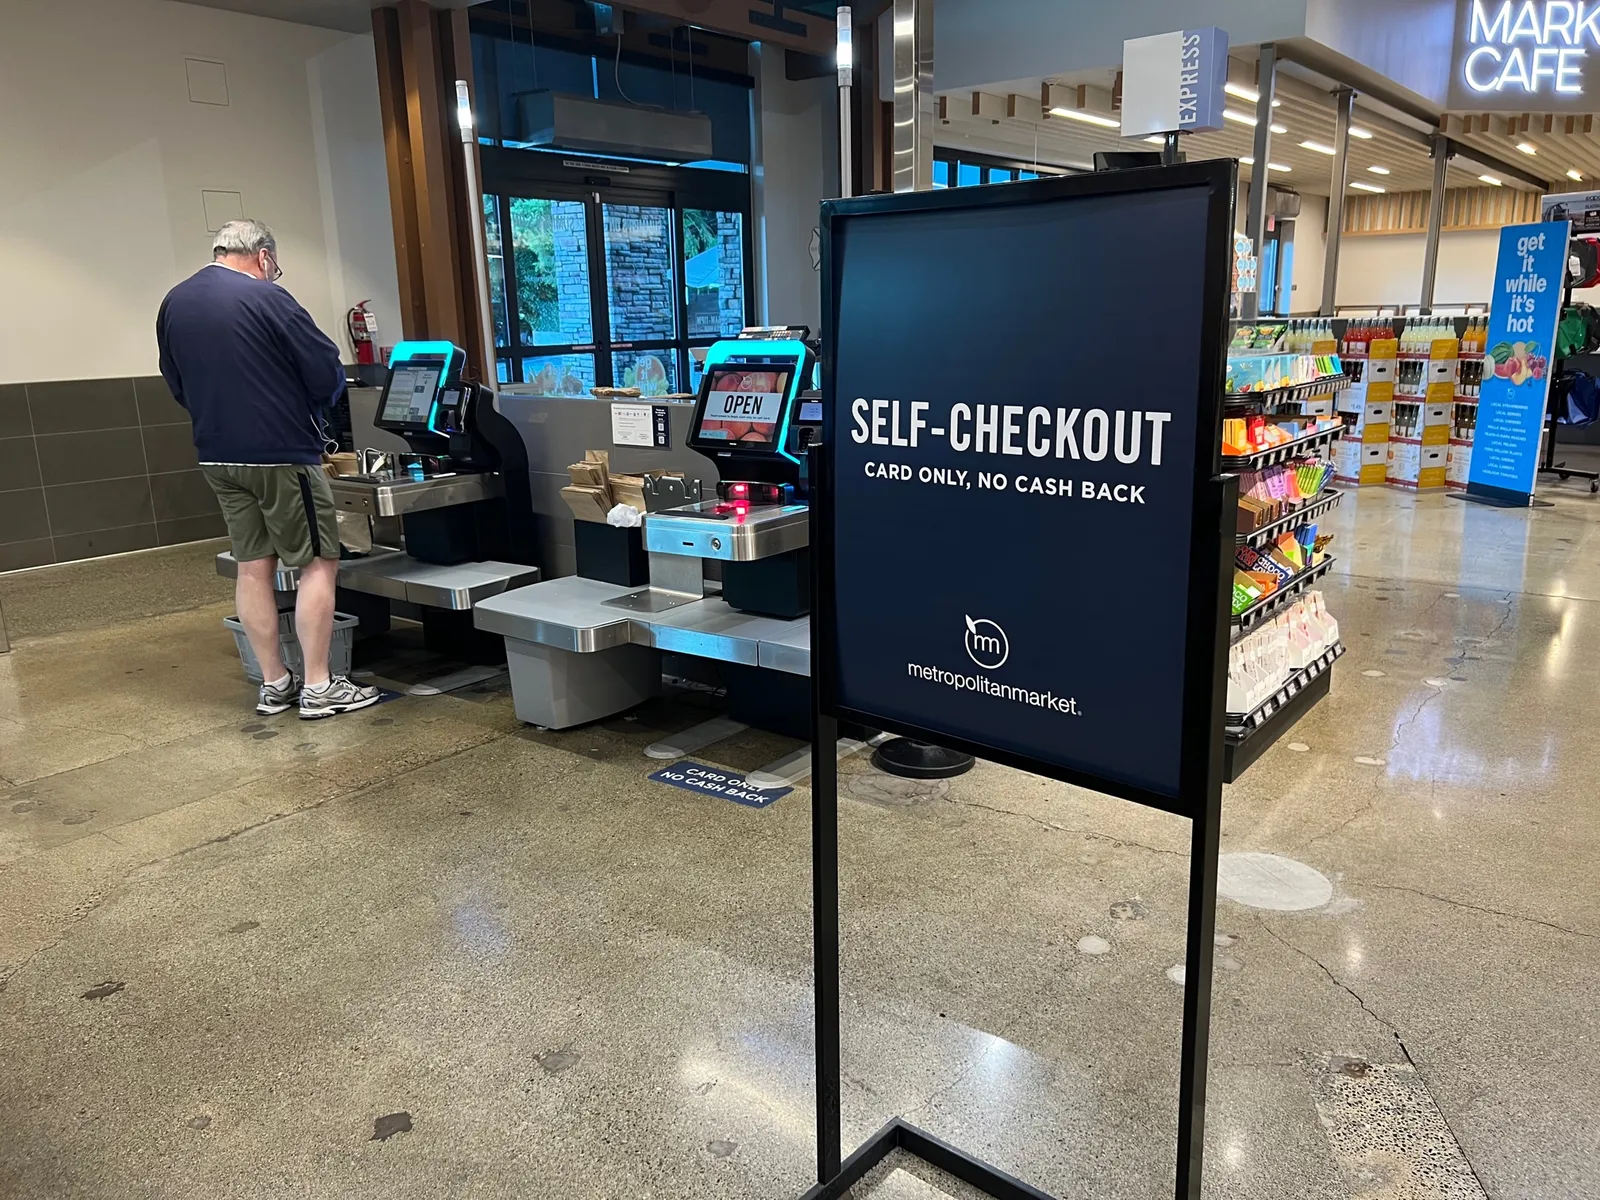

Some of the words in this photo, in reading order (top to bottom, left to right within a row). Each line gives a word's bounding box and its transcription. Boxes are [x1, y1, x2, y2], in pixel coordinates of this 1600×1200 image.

[1469, 0, 1600, 45] MARK
[1179, 34, 1200, 124] EXPRESS
[1464, 46, 1586, 92] CAFE
[1517, 232, 1545, 256] get
[1522, 253, 1535, 272] it
[1505, 273, 1547, 293] while
[1510, 294, 1535, 313] it's
[1506, 314, 1535, 333] hot
[724, 394, 763, 415] OPEN
[851, 397, 1172, 466] SELF-CHECKOUT
[864, 461, 913, 481] CARD
[918, 466, 971, 490] ONLY,
[977, 471, 1008, 491] NO
[1014, 475, 1073, 497] CASH
[1081, 480, 1146, 504] BACK
[660, 771, 685, 781] NO
[685, 778, 726, 792] CASH
[725, 787, 770, 803] BACK
[685, 768, 726, 782] CARD
